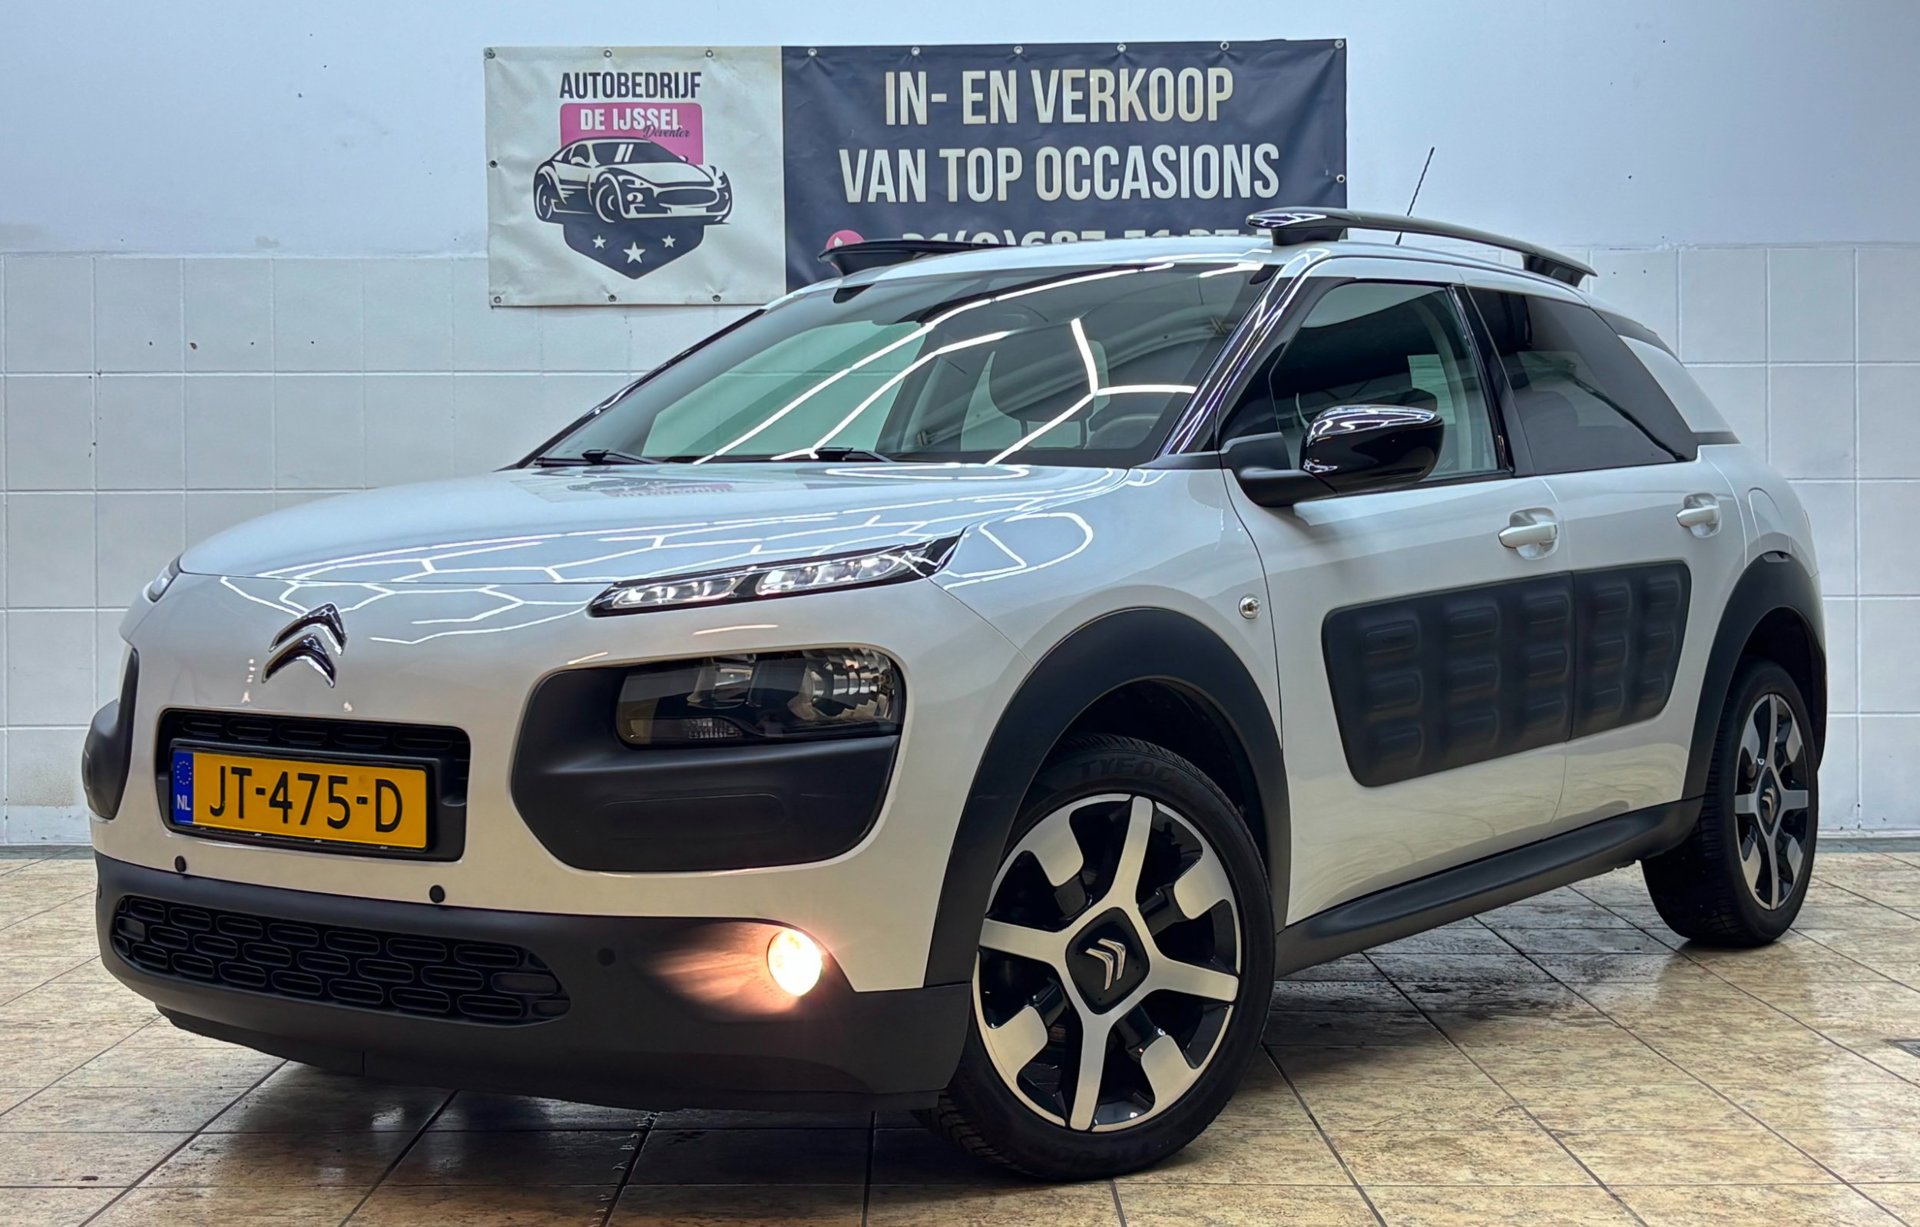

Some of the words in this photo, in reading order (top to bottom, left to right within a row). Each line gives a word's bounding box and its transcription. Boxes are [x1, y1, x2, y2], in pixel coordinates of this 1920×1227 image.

[560, 72, 702, 99] AUTOBEDRIJF
[885, 71, 947, 126] IN-
[963, 69, 1018, 124] EN
[1031, 67, 1234, 123] VERKOOP
[580, 108, 605, 130] DE
[612, 108, 682, 130] IJSSEL
[838, 148, 926, 202] VAN
[939, 147, 1023, 201] TOP
[1036, 143, 1280, 201] OCCASIONS
[176, 795, 192, 811] NL
[209, 765, 403, 833] JT-475-D
